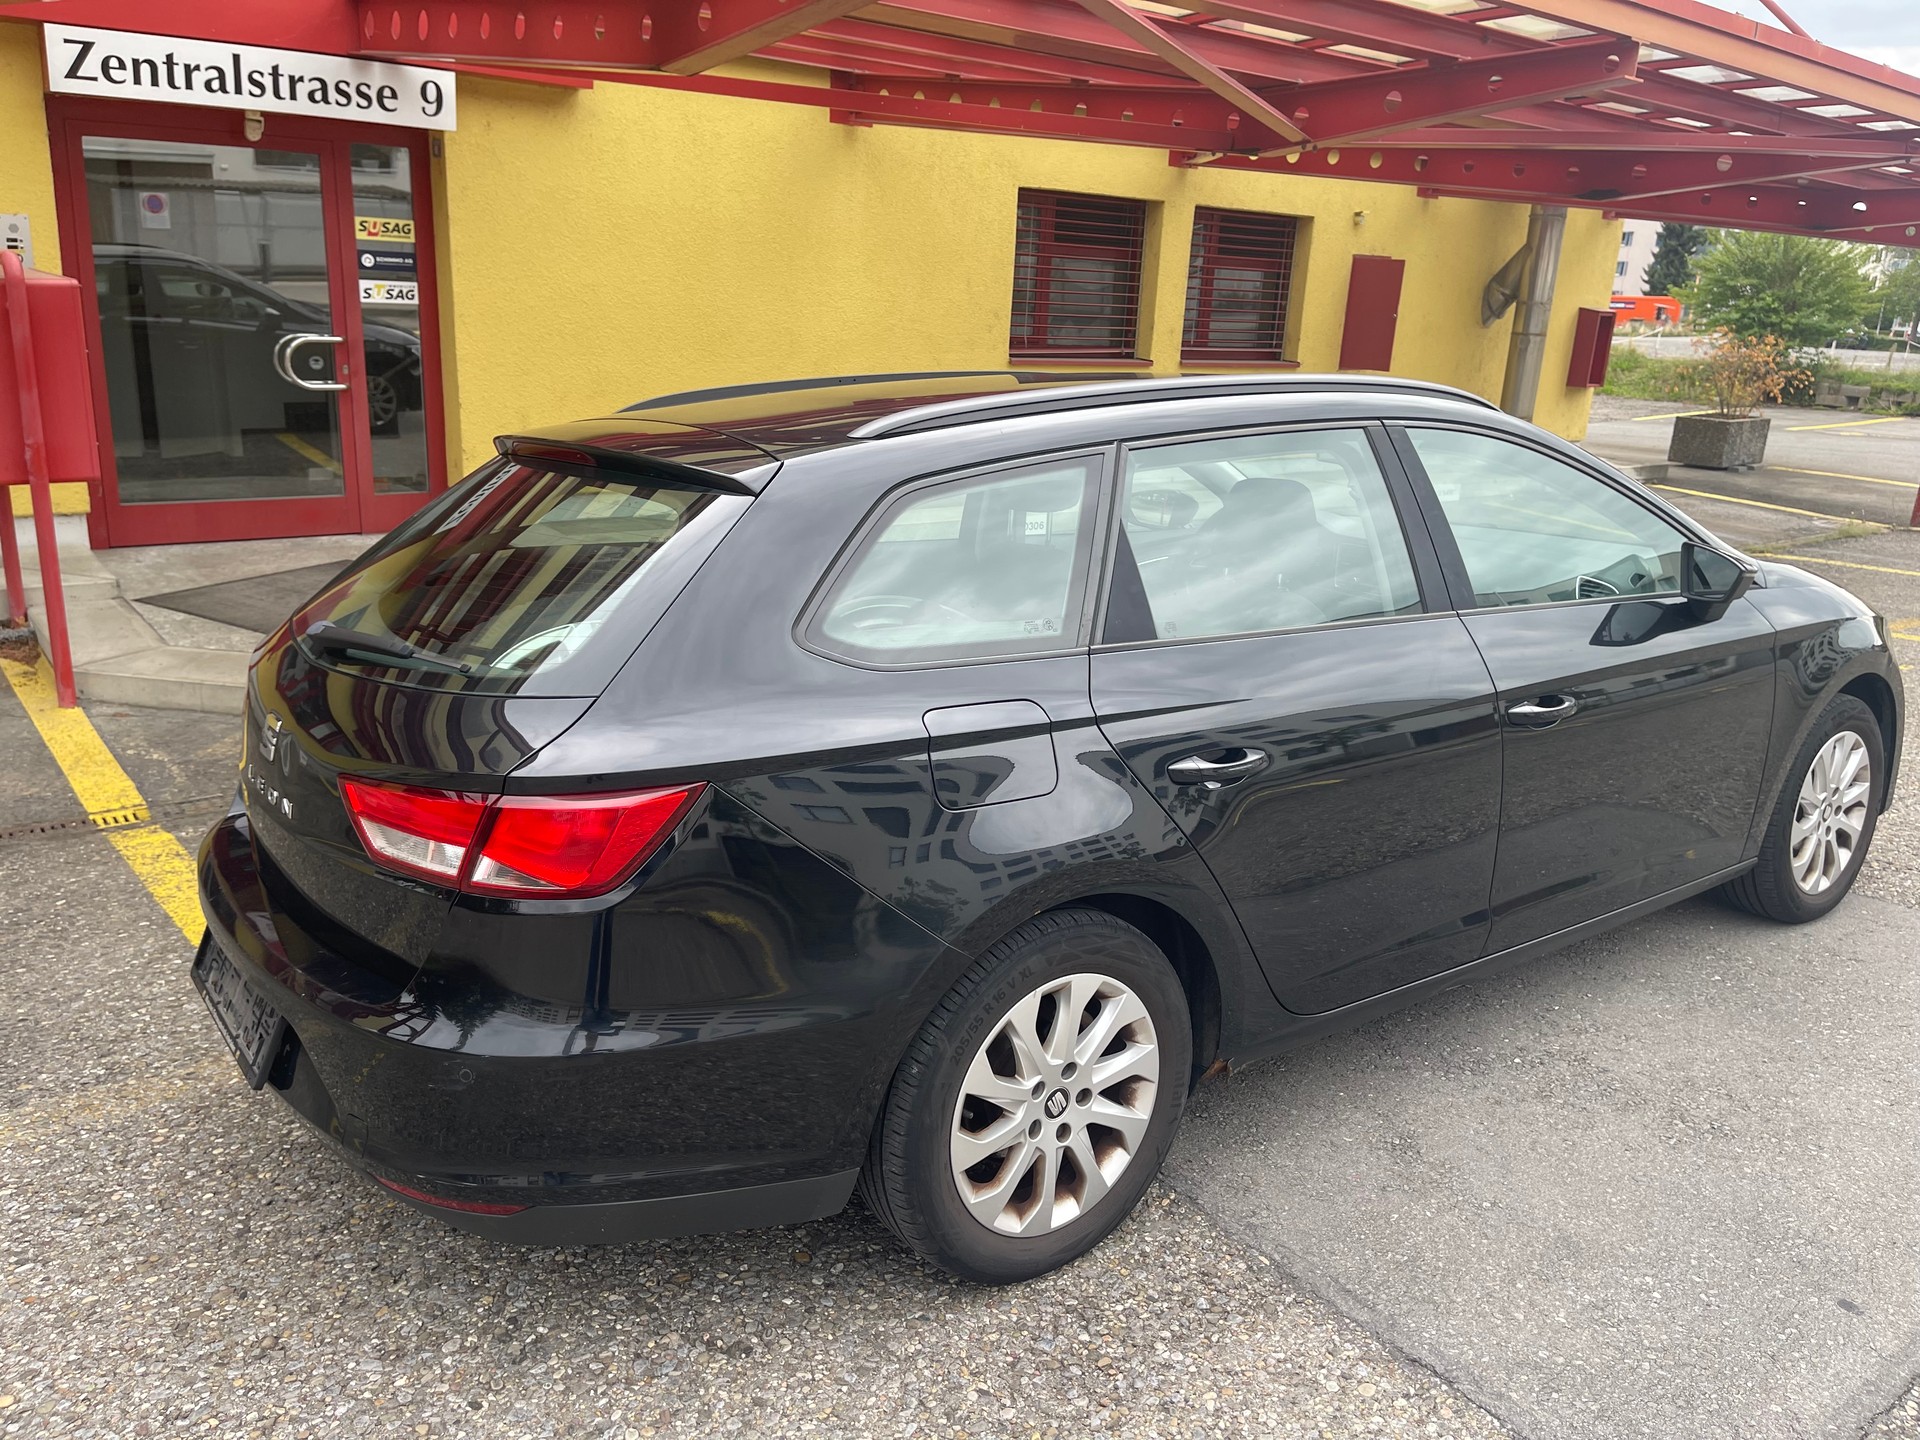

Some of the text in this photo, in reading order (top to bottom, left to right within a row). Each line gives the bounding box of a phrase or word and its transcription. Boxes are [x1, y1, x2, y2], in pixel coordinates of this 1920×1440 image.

[62, 37, 444, 117] Zentralstrasse 9
[359, 220, 411, 236] SUSAG
[247, 763, 294, 820] LEON
[950, 1014, 985, 1067] 205/55
[982, 1002, 995, 1016] R
[992, 987, 1007, 1005] 16
